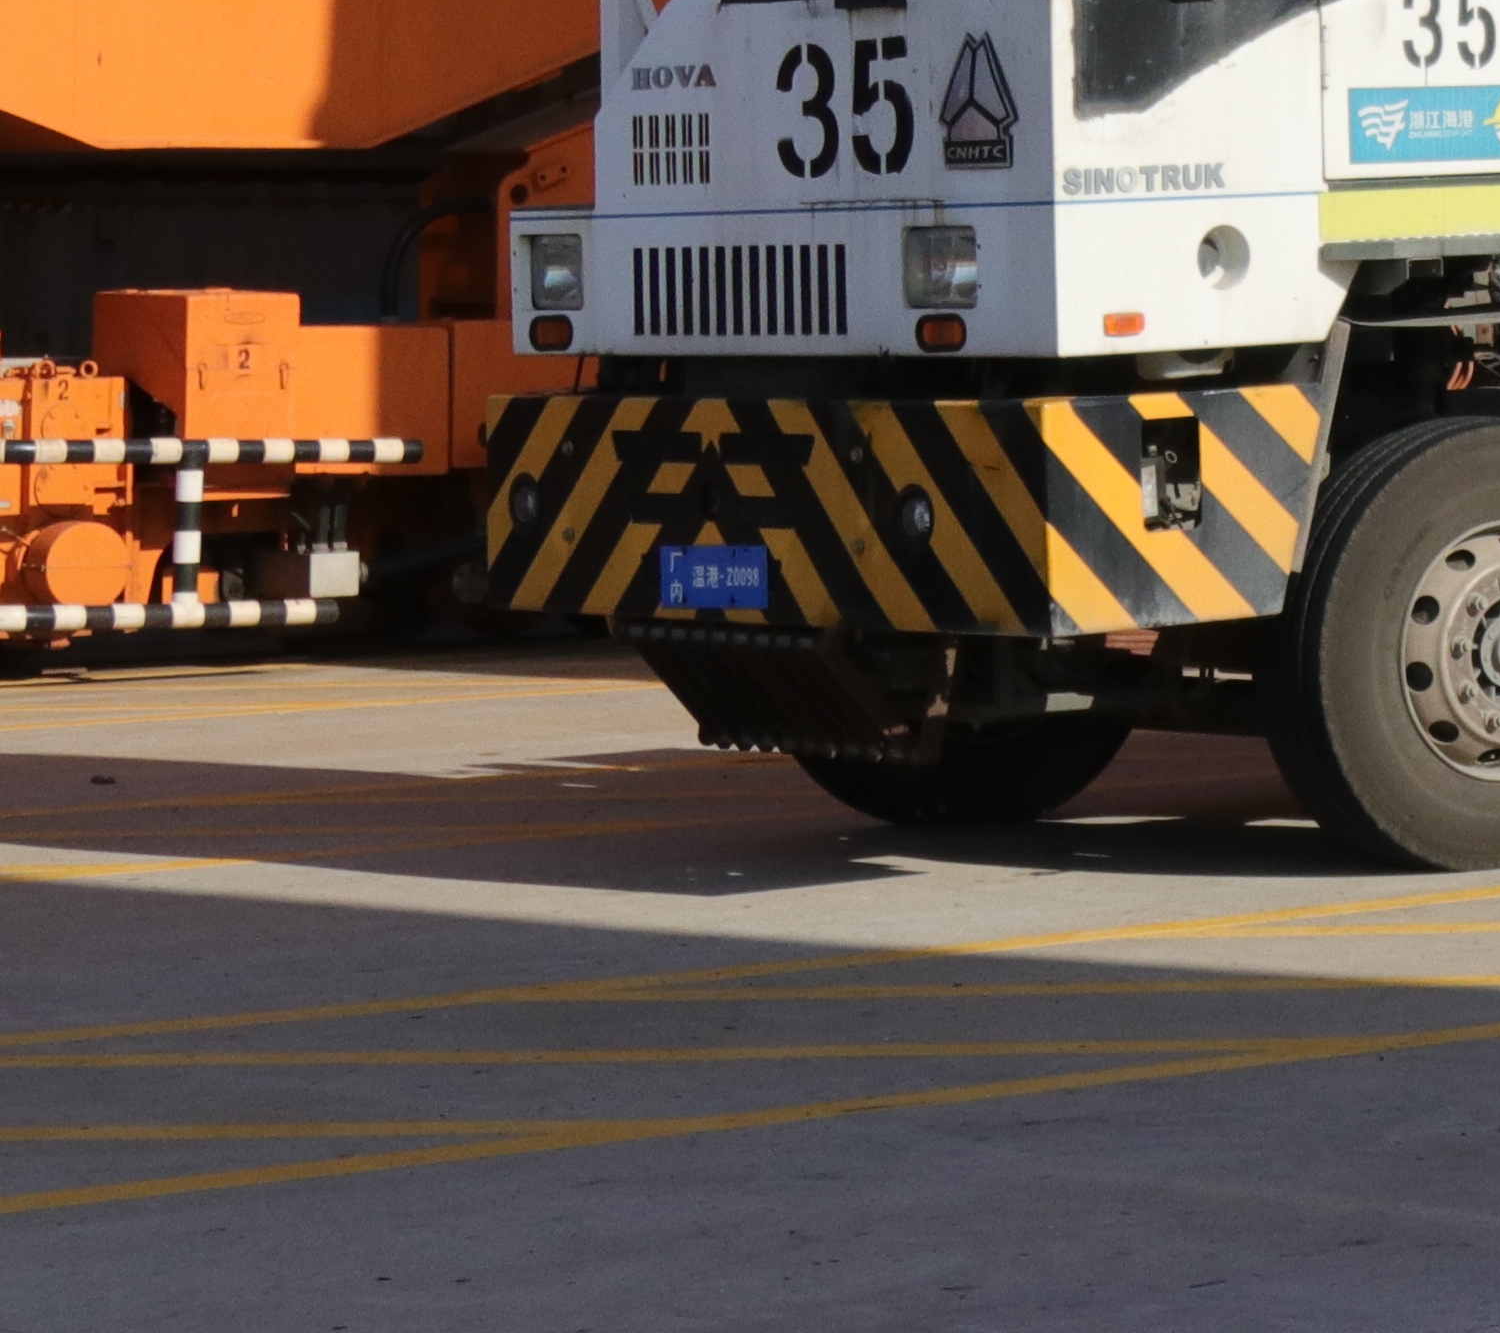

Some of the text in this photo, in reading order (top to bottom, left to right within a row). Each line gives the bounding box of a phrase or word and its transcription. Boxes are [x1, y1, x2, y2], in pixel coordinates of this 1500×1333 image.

[631, 64, 717, 92] HOVA
[776, 35, 916, 180] 35
[1408, 109, 1474, 130] 浙江海港
[946, 144, 1006, 164] CNHTC
[1062, 164, 1226, 197] SINOTRUK
